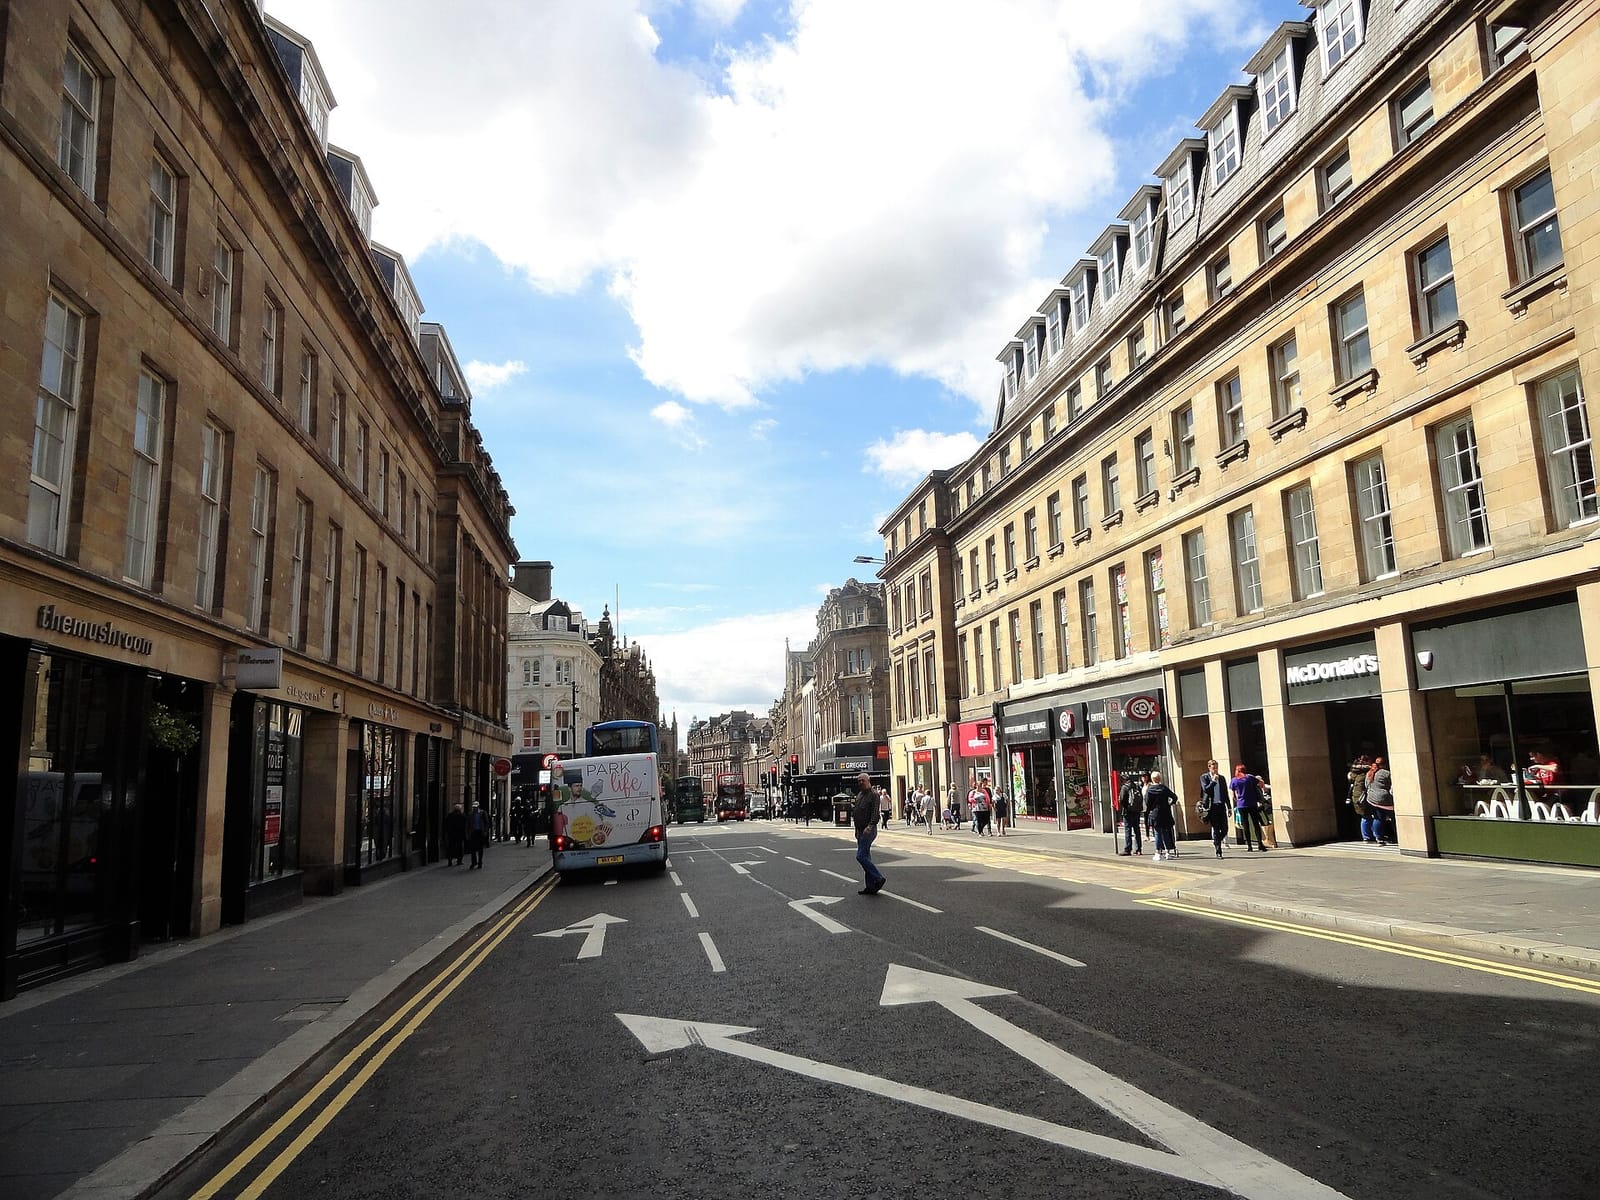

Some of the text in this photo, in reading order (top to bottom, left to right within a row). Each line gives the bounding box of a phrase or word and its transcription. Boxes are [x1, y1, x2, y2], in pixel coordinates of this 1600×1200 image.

[37, 604, 153, 656] themushroom
[1286, 654, 1379, 684] McDonald's
[274, 754, 284, 769] LET
[586, 761, 631, 777] PARK
[845, 761, 868, 769] GREGGS
[611, 772, 642, 798] life
